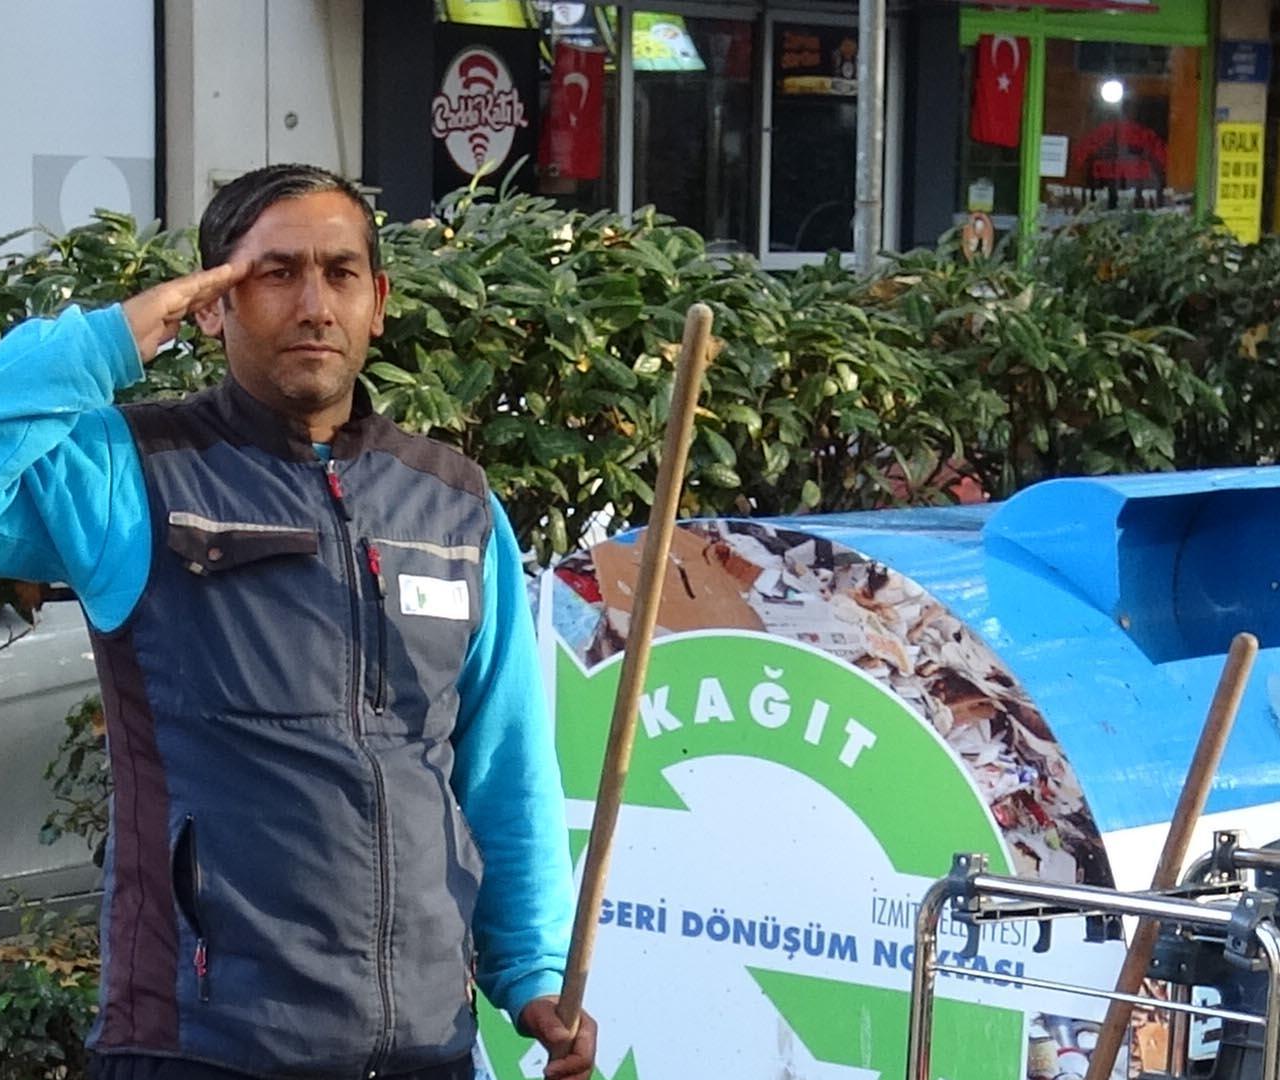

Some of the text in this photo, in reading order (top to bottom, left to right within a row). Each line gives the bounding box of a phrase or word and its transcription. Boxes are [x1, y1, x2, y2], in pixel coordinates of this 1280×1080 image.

[638, 664, 878, 769] KAĞIT
[598, 898, 667, 934] GERİ
[681, 907, 859, 963] DÖNÜŞÜM
